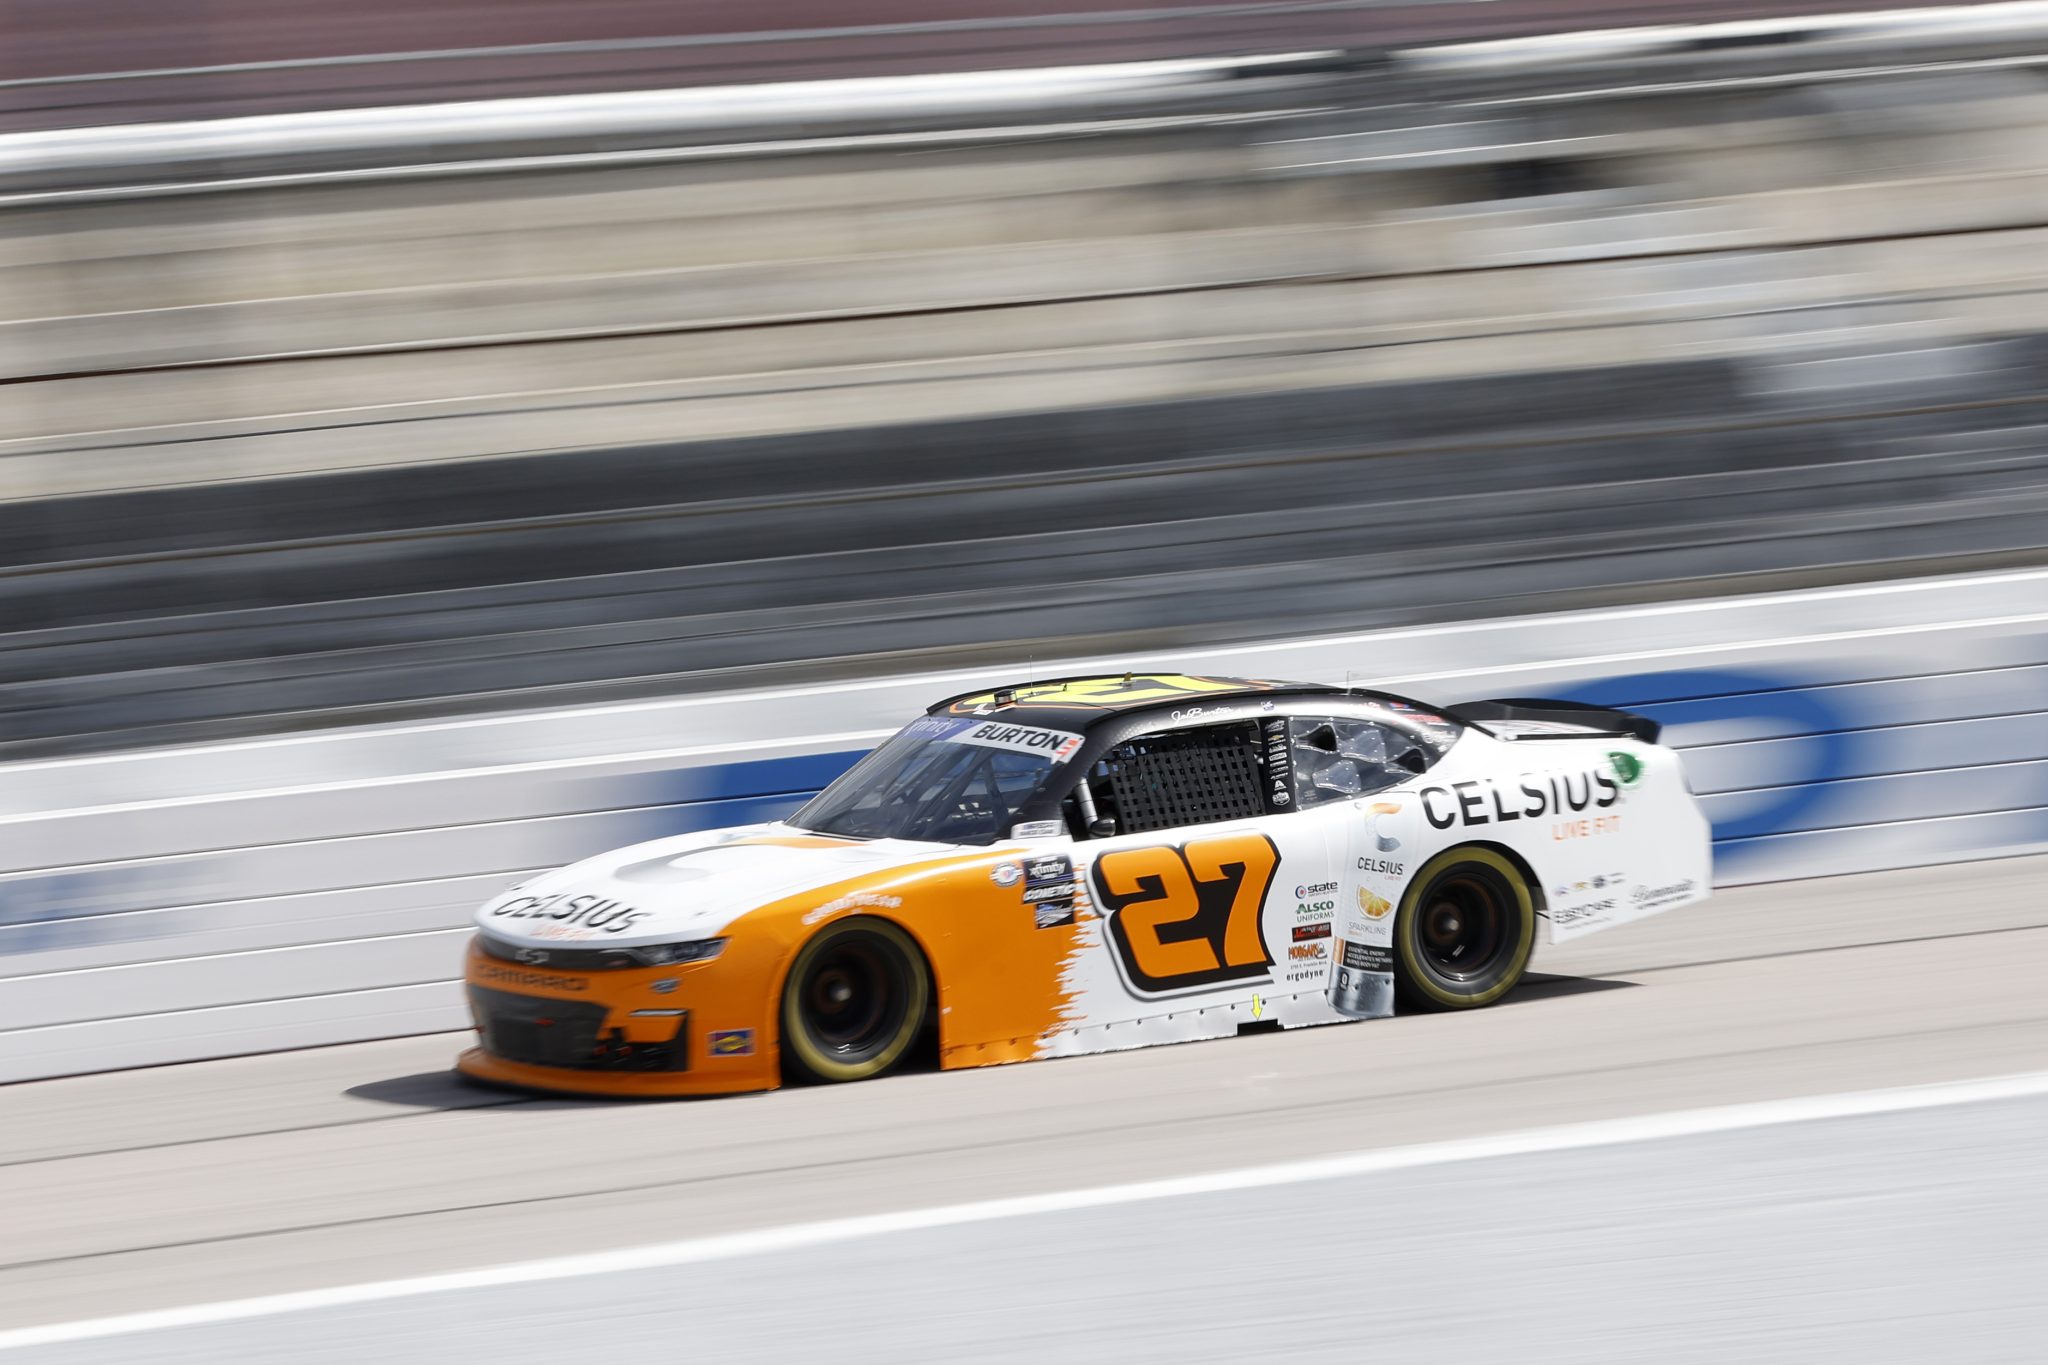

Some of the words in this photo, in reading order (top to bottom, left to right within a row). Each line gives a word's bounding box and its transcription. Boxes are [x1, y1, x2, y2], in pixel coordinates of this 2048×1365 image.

[972, 723, 1068, 751] BURTON
[1419, 769, 1619, 830] CELSIUS
[1357, 856, 1404, 876] CELSIUS
[1307, 881, 1339, 894] state
[492, 894, 653, 932] CELSIUS
[1098, 832, 1278, 979] 27
[1297, 900, 1335, 914] ALSCO
[1297, 911, 1335, 924] UNIFORMS
[1286, 968, 1324, 982] ergodyne
